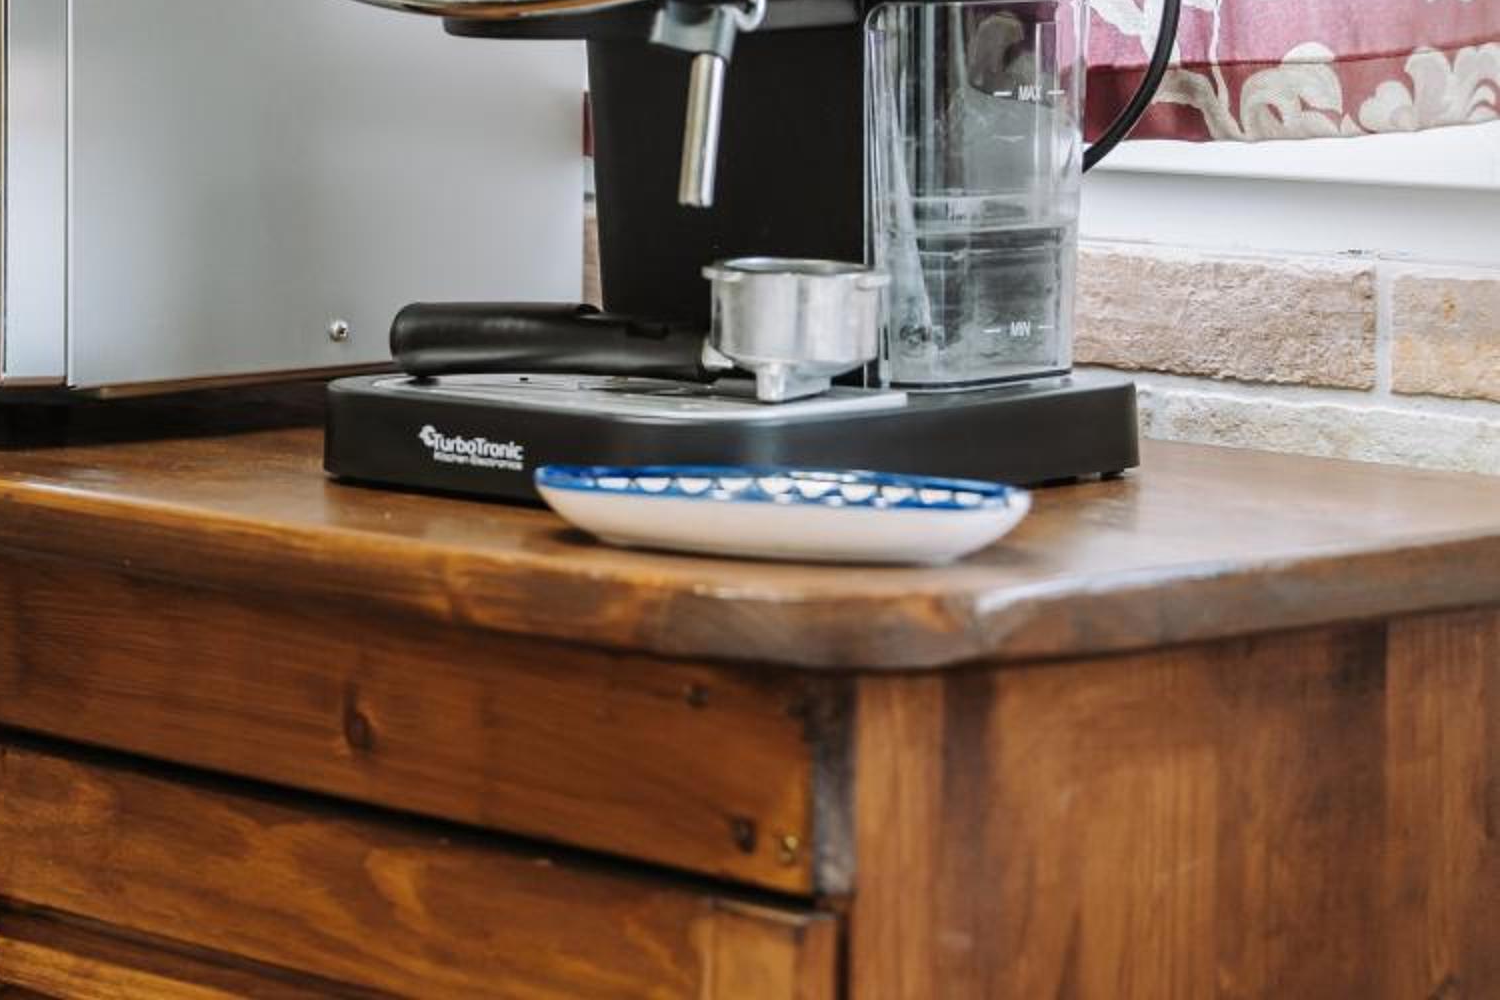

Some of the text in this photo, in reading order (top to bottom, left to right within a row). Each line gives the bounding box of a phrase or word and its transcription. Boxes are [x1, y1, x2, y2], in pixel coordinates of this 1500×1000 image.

[1017, 84, 1042, 101] MAX
[1010, 320, 1031, 337] MIN
[433, 432, 525, 460] TurboTronic
